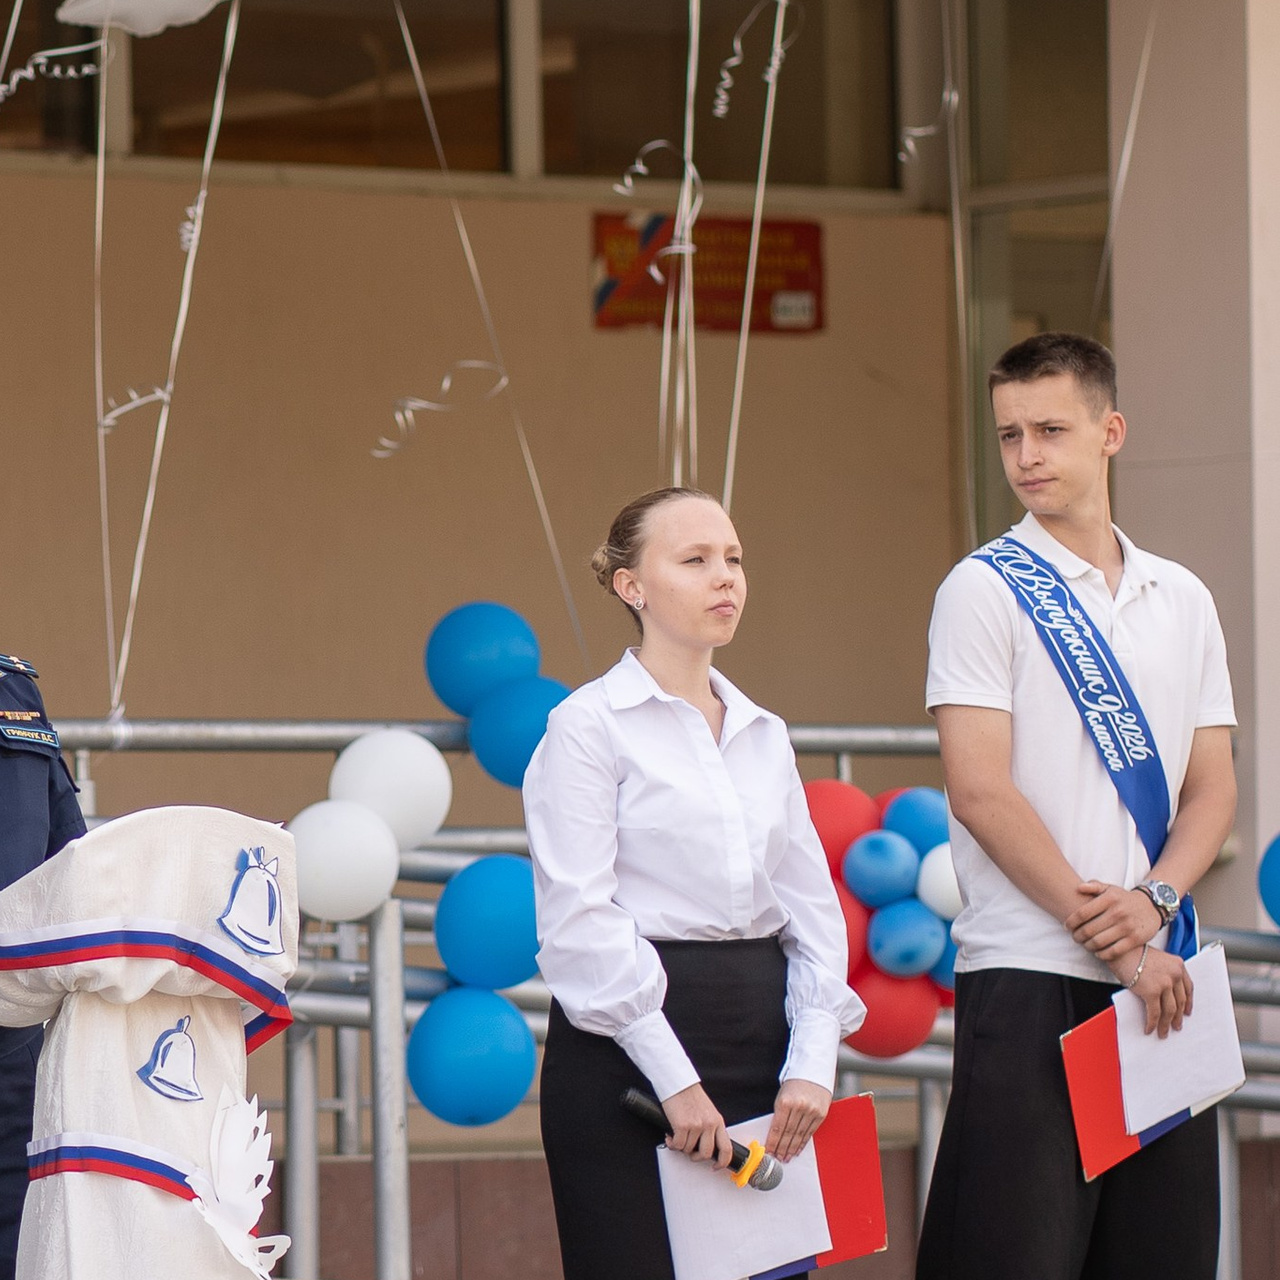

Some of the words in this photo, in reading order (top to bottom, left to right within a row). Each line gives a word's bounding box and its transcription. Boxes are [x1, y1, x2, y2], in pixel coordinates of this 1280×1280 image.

[993, 551, 1108, 695] Выпускник
[1085, 710, 1125, 773] класса
[1111, 711, 1155, 762] 2026
